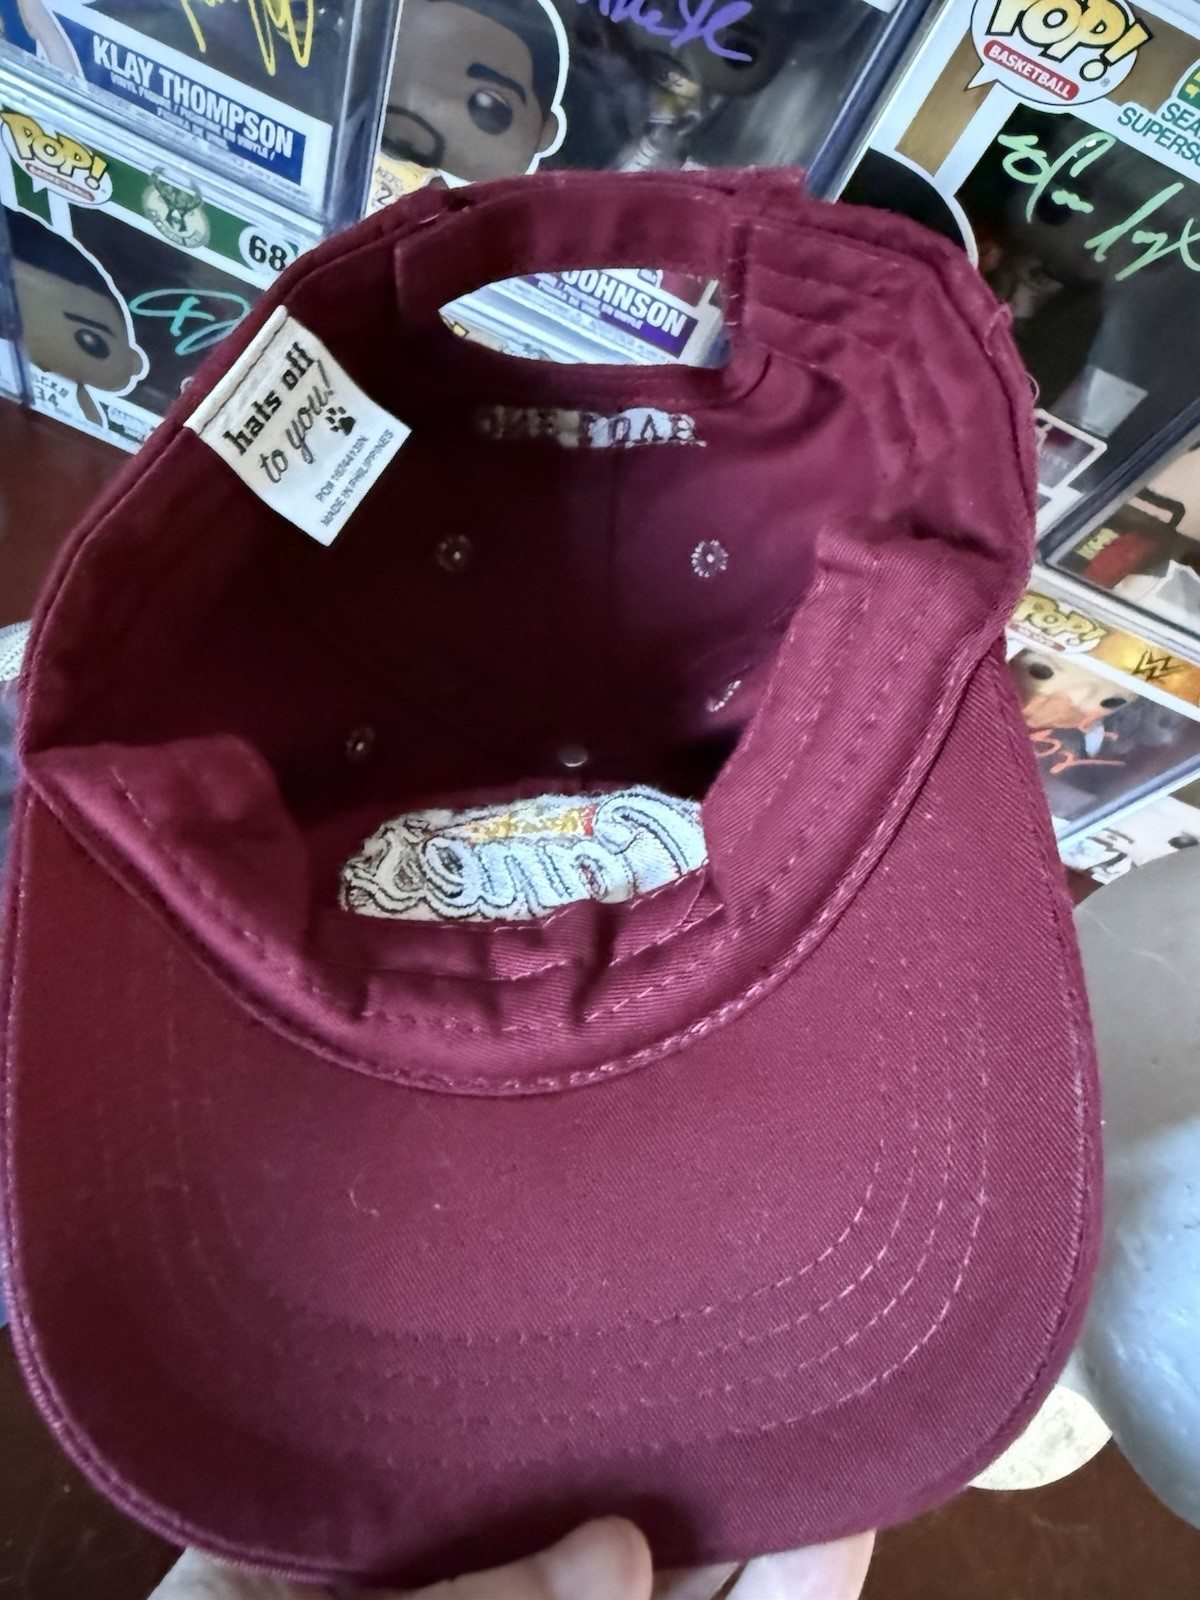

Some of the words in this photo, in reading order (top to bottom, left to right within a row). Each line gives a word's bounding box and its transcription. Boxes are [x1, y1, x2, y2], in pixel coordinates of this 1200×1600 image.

[93, 35, 153, 88] KLAY
[158, 67, 294, 158] THOMPSON
[989, 45, 1070, 99] BASKETBALL
[0, 112, 108, 191] POP!
[248, 234, 288, 272] 68
[222, 387, 282, 455] hats
[281, 341, 315, 391] off
[259, 448, 289, 484] to
[285, 359, 335, 465] you!
[321, 496, 346, 526] MADE
[348, 429, 394, 487] PHILIPPINES
[1009, 590, 1110, 648] POP!
